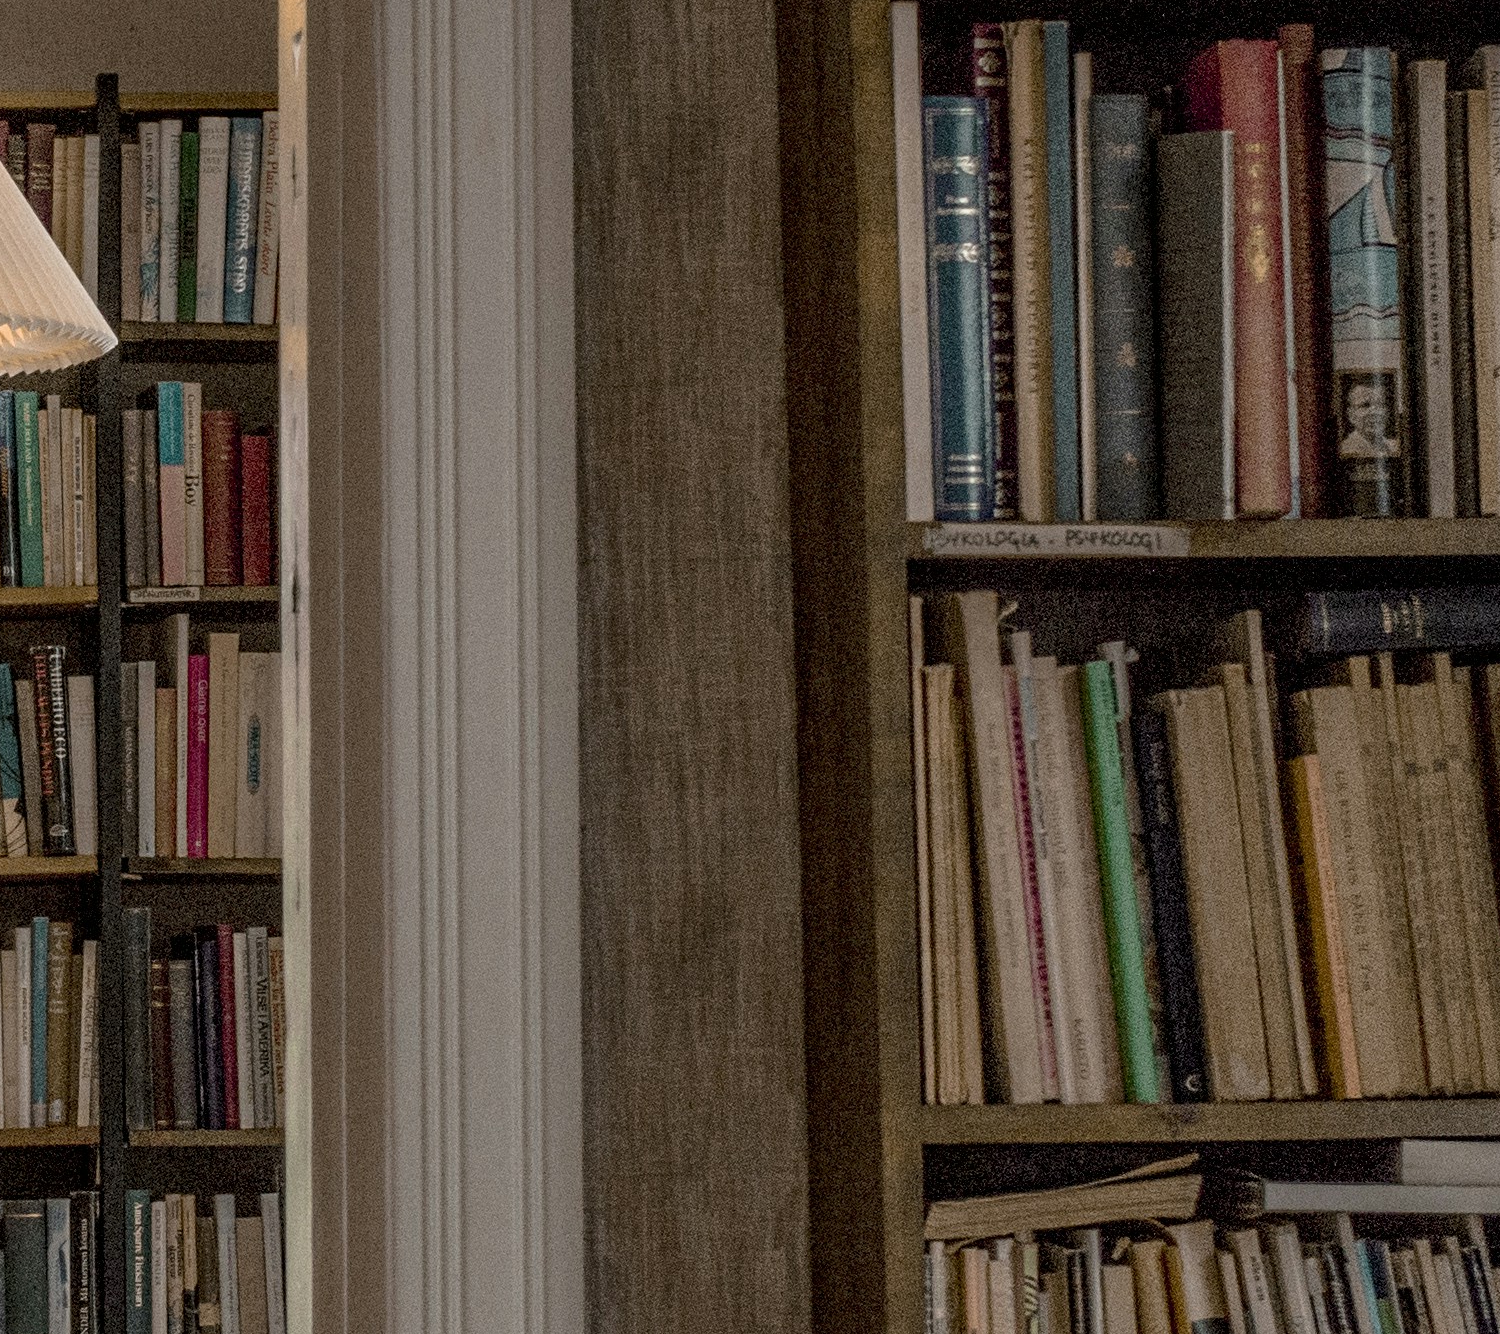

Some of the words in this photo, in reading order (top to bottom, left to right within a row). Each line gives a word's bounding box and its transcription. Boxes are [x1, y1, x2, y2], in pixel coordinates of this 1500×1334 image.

[266, 119, 278, 158] Belva
[265, 160, 276, 193] Plain
[184, 474, 201, 507] Boy
[1064, 528, 1161, 549] PSYKOLOGI
[49, 653, 66, 723] UMBERTO
[195, 679, 209, 712] Game
[54, 726, 67, 759] ECO
[196, 715, 207, 742] over
[255, 978, 268, 1011] VILSE
[257, 1020, 270, 1078] AMERIKA
